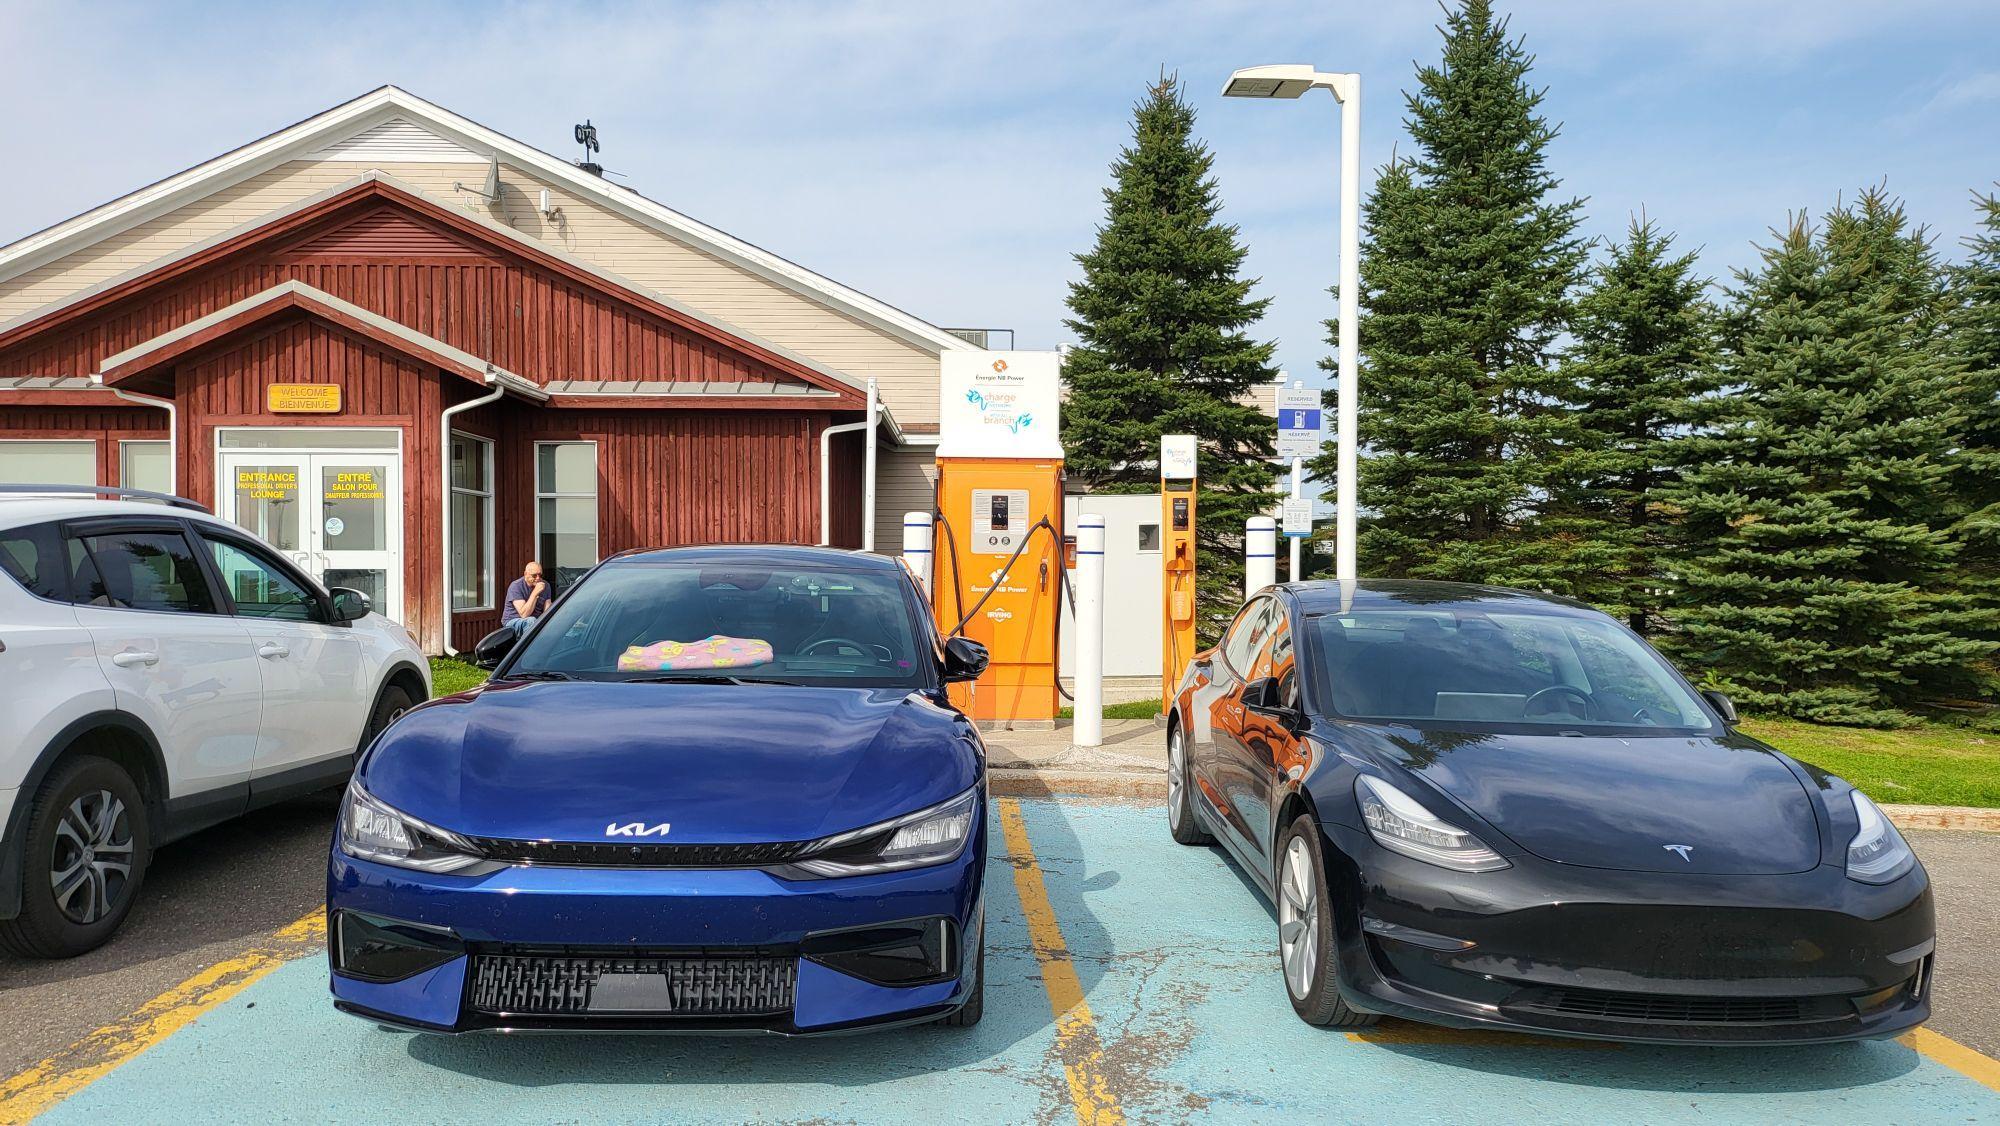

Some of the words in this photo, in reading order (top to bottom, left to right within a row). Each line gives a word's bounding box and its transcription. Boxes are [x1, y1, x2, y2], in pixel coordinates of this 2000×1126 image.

[281, 387, 329, 397] WELCOME
[280, 400, 330, 409] BIENVENUE
[240, 472, 295, 482] ENTRANCE
[337, 472, 371, 482] ENTRÉ
[332, 483, 355, 491] SALON
[358, 483, 378, 491] POUR
[251, 490, 285, 498] LOUNGE
